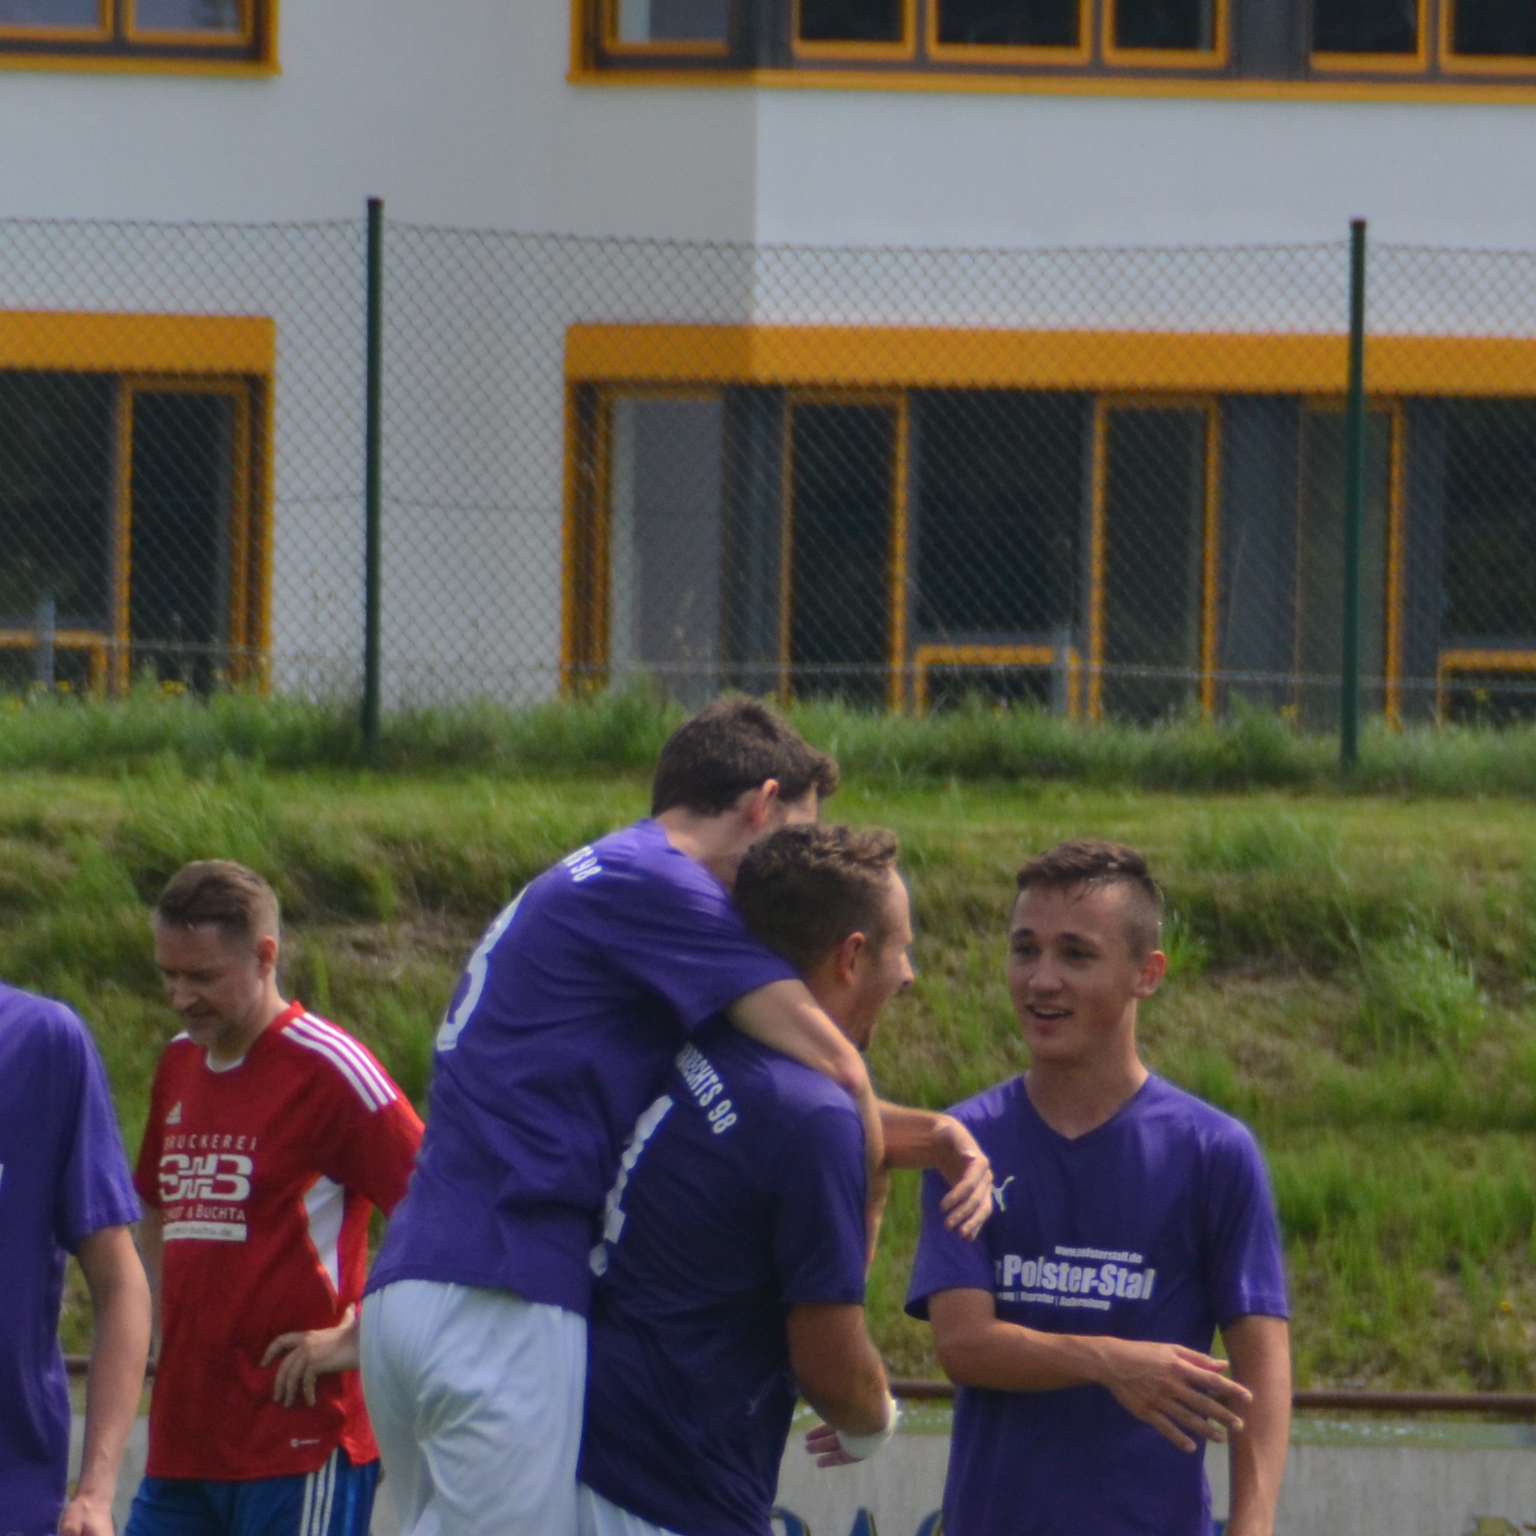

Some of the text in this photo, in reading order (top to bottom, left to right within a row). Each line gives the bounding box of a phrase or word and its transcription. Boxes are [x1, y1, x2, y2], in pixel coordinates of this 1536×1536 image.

[570, 856, 603, 883] 98
[707, 1098, 738, 1135] 98
[195, 1203, 246, 1222] BUCHTA
[1003, 1253, 1156, 1301] Polster-Stal
